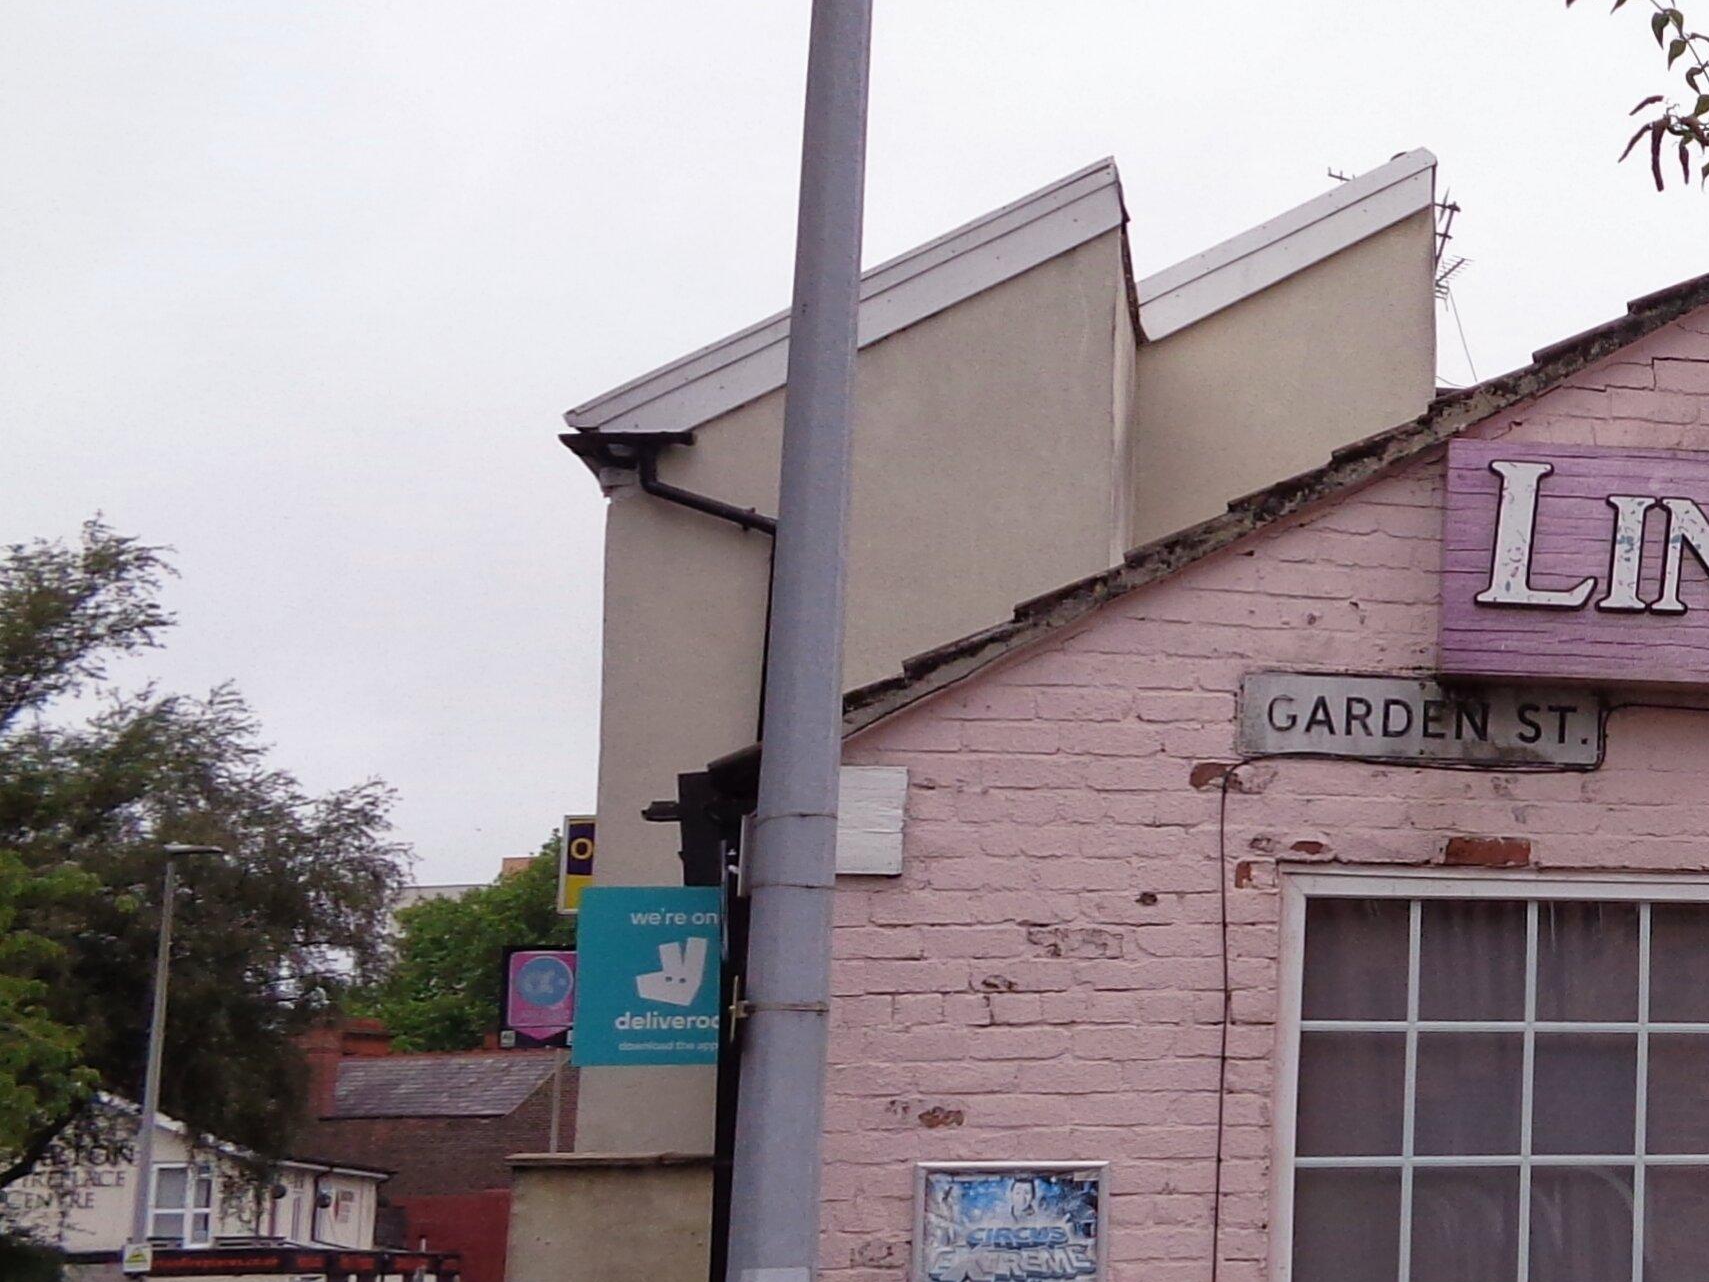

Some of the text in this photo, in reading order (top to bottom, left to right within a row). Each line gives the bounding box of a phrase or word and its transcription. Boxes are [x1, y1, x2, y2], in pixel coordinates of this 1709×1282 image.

[1267, 694, 1589, 745] GARDEN ST.
[630, 908, 718, 926] we're on
[966, 1226, 1069, 1248] CIRCUS
